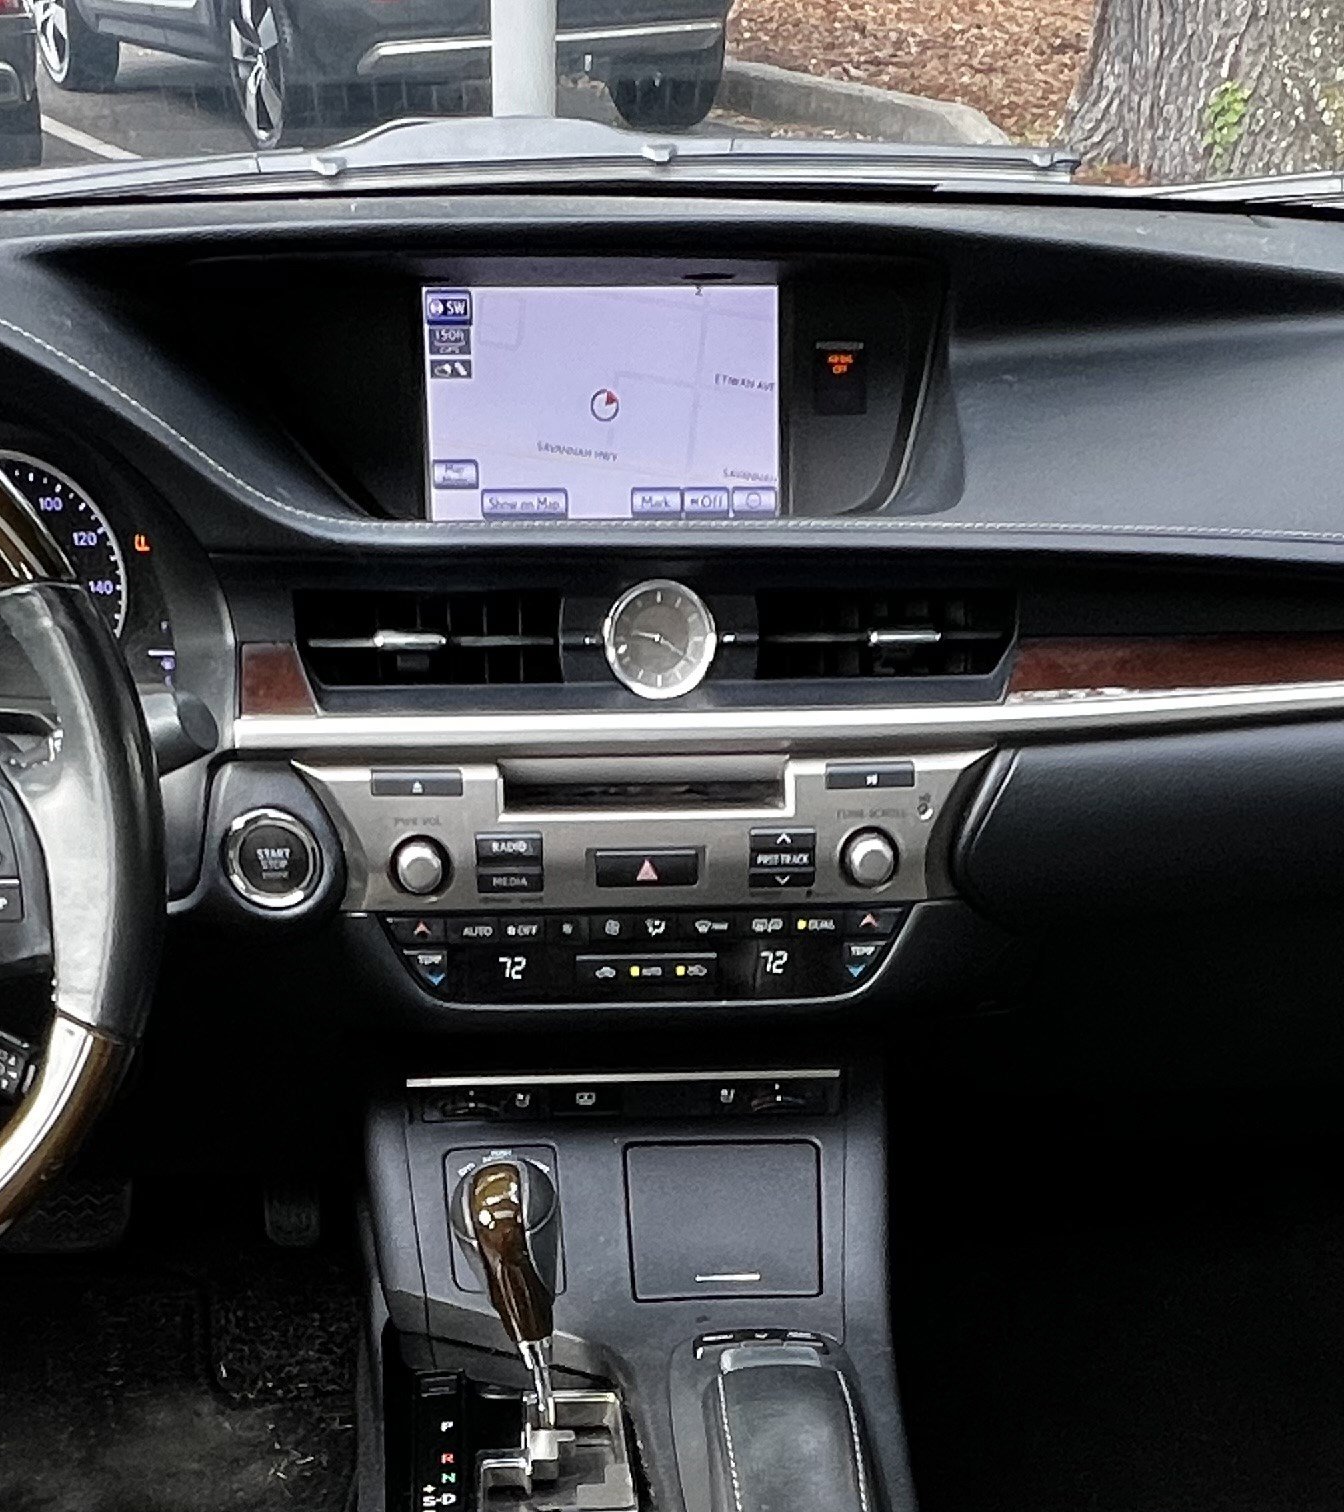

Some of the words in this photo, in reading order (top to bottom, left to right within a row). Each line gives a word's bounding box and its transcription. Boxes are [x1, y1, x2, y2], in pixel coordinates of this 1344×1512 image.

[446, 300, 466, 316] SW
[38, 497, 63, 511] 100
[72, 532, 97, 546] 120
[88, 580, 114, 594] 140
[492, 841, 527, 853] RADIO
[257, 848, 290, 860] START
[492, 876, 528, 888] MEDIA
[462, 926, 493, 937] AUTO
[498, 956, 527, 980] 72
[760, 950, 788, 974] 72
[440, 1421, 454, 1432] P
[441, 1453, 455, 1464] R
[441, 1472, 456, 1484] N
